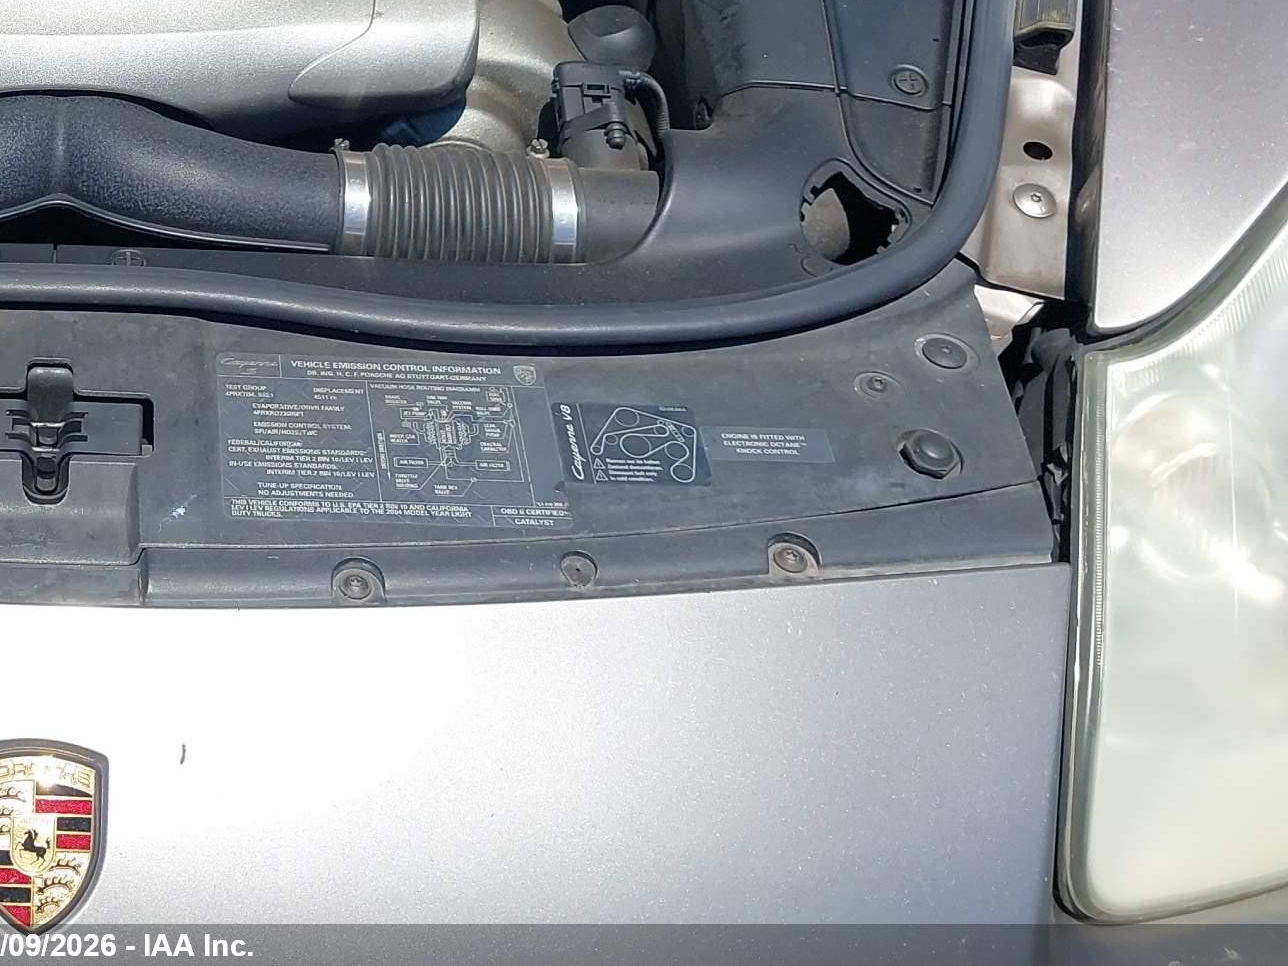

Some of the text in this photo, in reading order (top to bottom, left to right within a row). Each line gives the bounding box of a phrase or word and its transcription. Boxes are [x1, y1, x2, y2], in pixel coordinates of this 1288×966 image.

[291, 360, 501, 375] VEHICLE EMISSION CONTROL INFORMATION
[560, 404, 572, 421] V8
[515, 518, 555, 526] CATALYST
